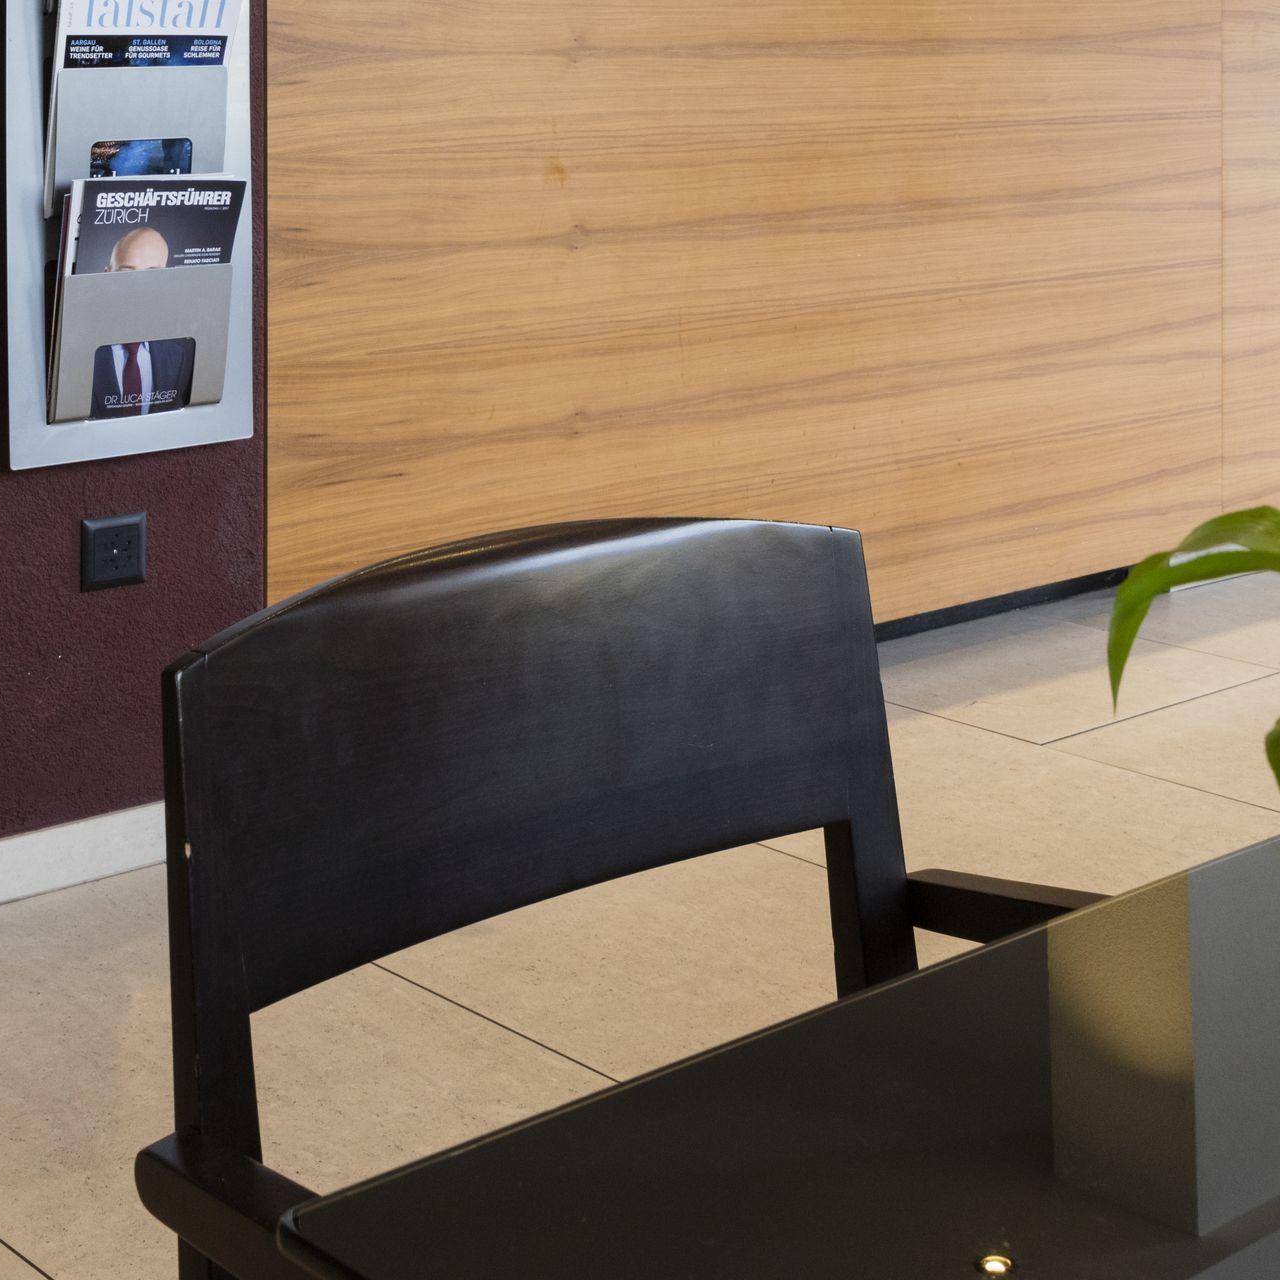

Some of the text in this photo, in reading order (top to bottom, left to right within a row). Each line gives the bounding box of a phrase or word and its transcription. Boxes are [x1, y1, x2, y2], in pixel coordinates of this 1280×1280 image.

[125, 51, 137, 59] FÜR
[208, 44, 221, 52] FÜR
[96, 188, 232, 208] GESCHÄFTSFÜHRER
[94, 208, 150, 225] ZÜRICH
[104, 394, 118, 405] DR.
[121, 393, 143, 404] LUCA
[146, 389, 177, 401] STÄGER
